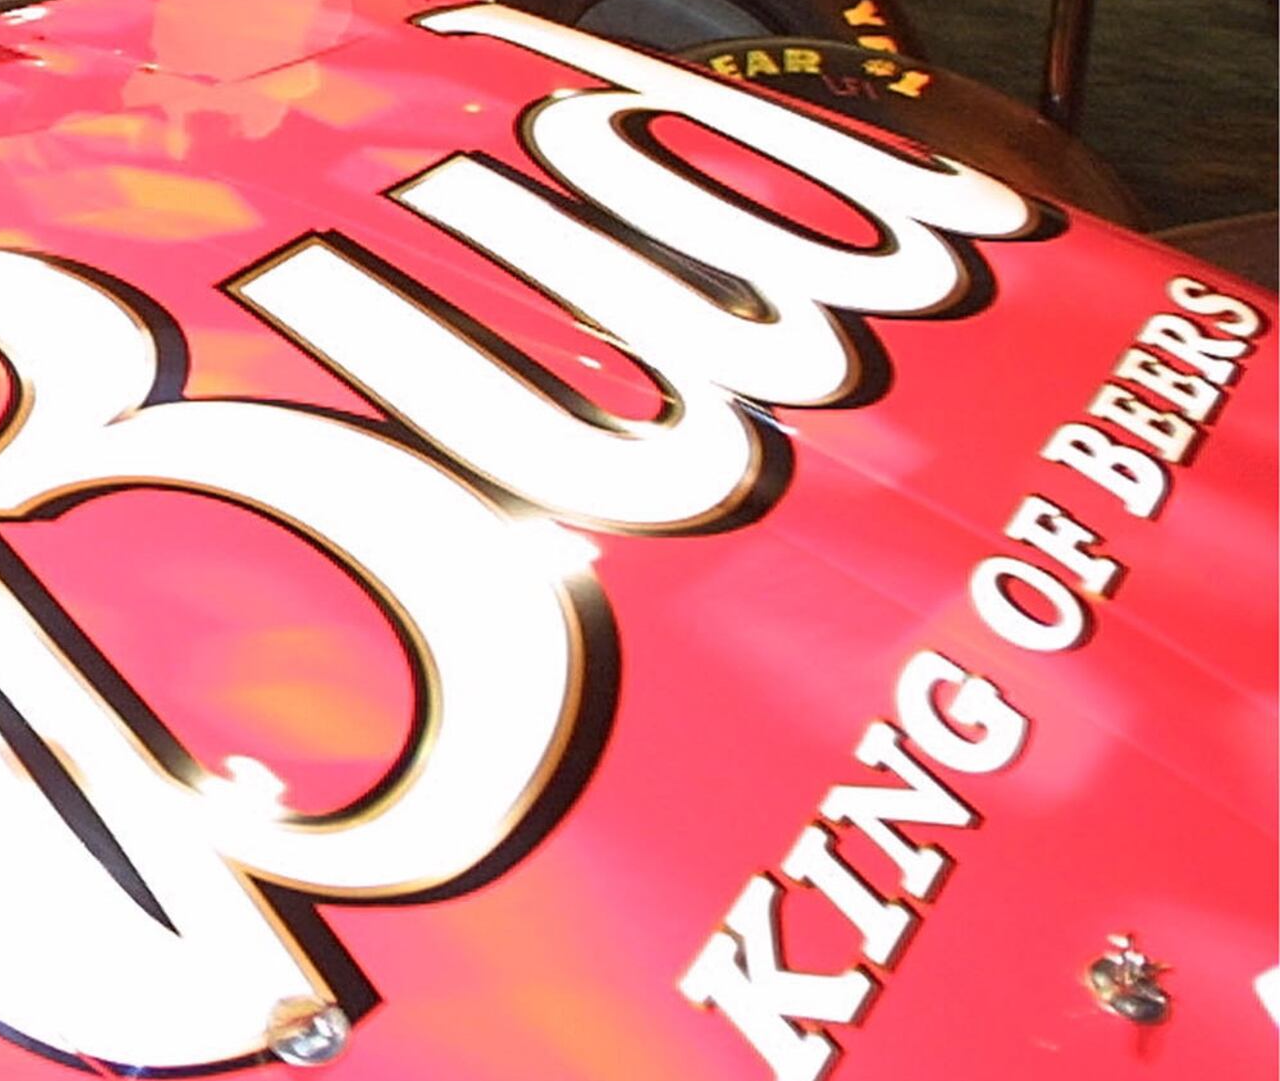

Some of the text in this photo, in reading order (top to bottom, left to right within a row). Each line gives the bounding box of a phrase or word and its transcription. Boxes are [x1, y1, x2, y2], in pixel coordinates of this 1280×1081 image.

[677, 275, 1271, 1081] KING OF BEERS
